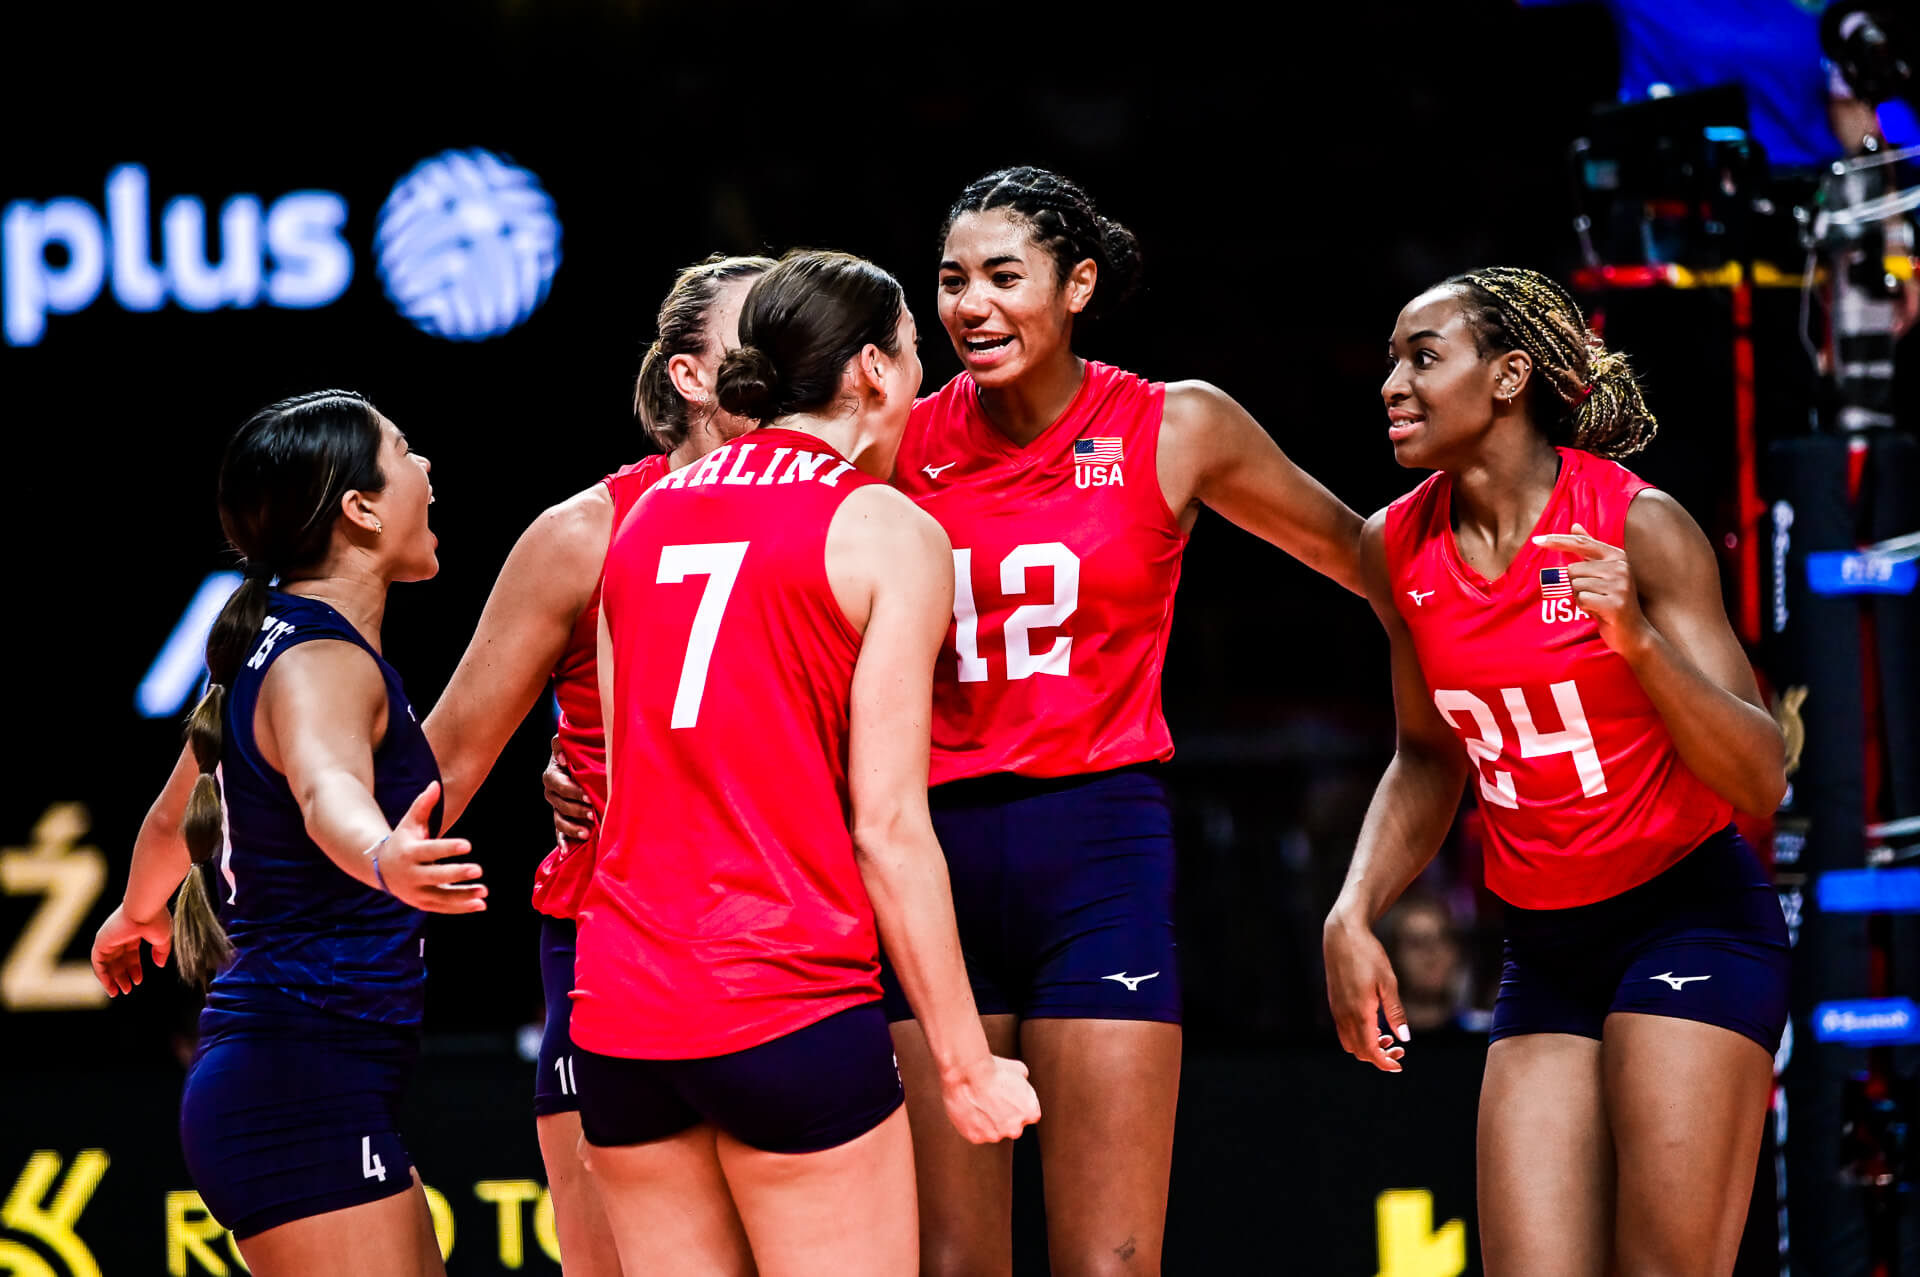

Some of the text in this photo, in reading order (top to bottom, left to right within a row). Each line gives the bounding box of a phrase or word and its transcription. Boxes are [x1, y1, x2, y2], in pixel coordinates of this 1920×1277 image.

[2, 162, 355, 347] plus
[1074, 463, 1125, 489] USA
[656, 541, 750, 729] 7
[952, 542, 1080, 683] 12
[1541, 598, 1590, 624] USA
[1434, 680, 1608, 810] 24
[361, 1135, 386, 1182] 4
